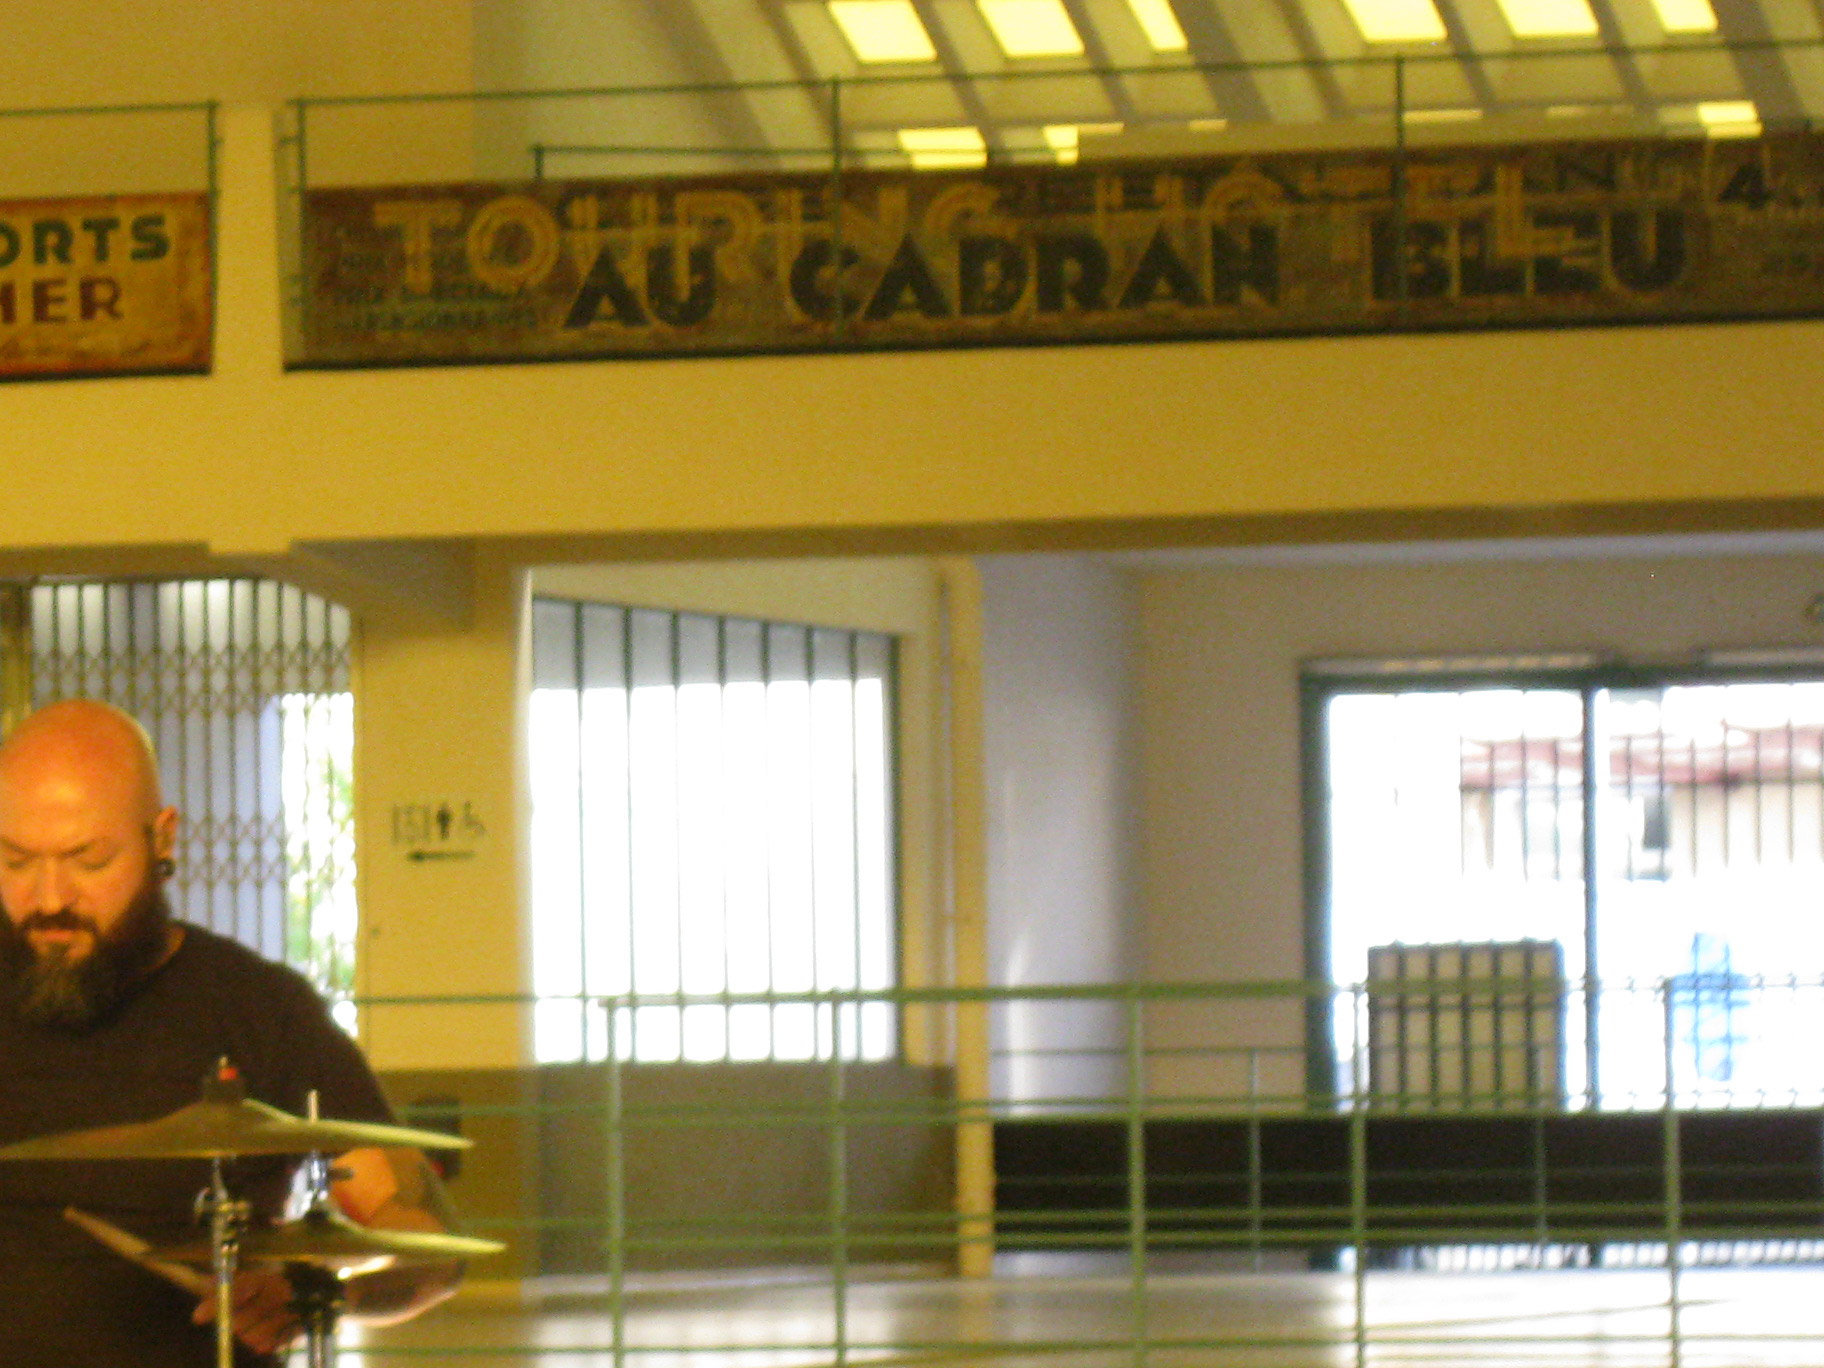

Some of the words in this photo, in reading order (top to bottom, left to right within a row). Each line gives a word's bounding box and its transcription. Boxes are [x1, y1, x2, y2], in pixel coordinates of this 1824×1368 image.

[563, 232, 718, 328] AU
[787, 218, 1278, 322] CADRAN
[1370, 208, 1684, 300] BLEU
